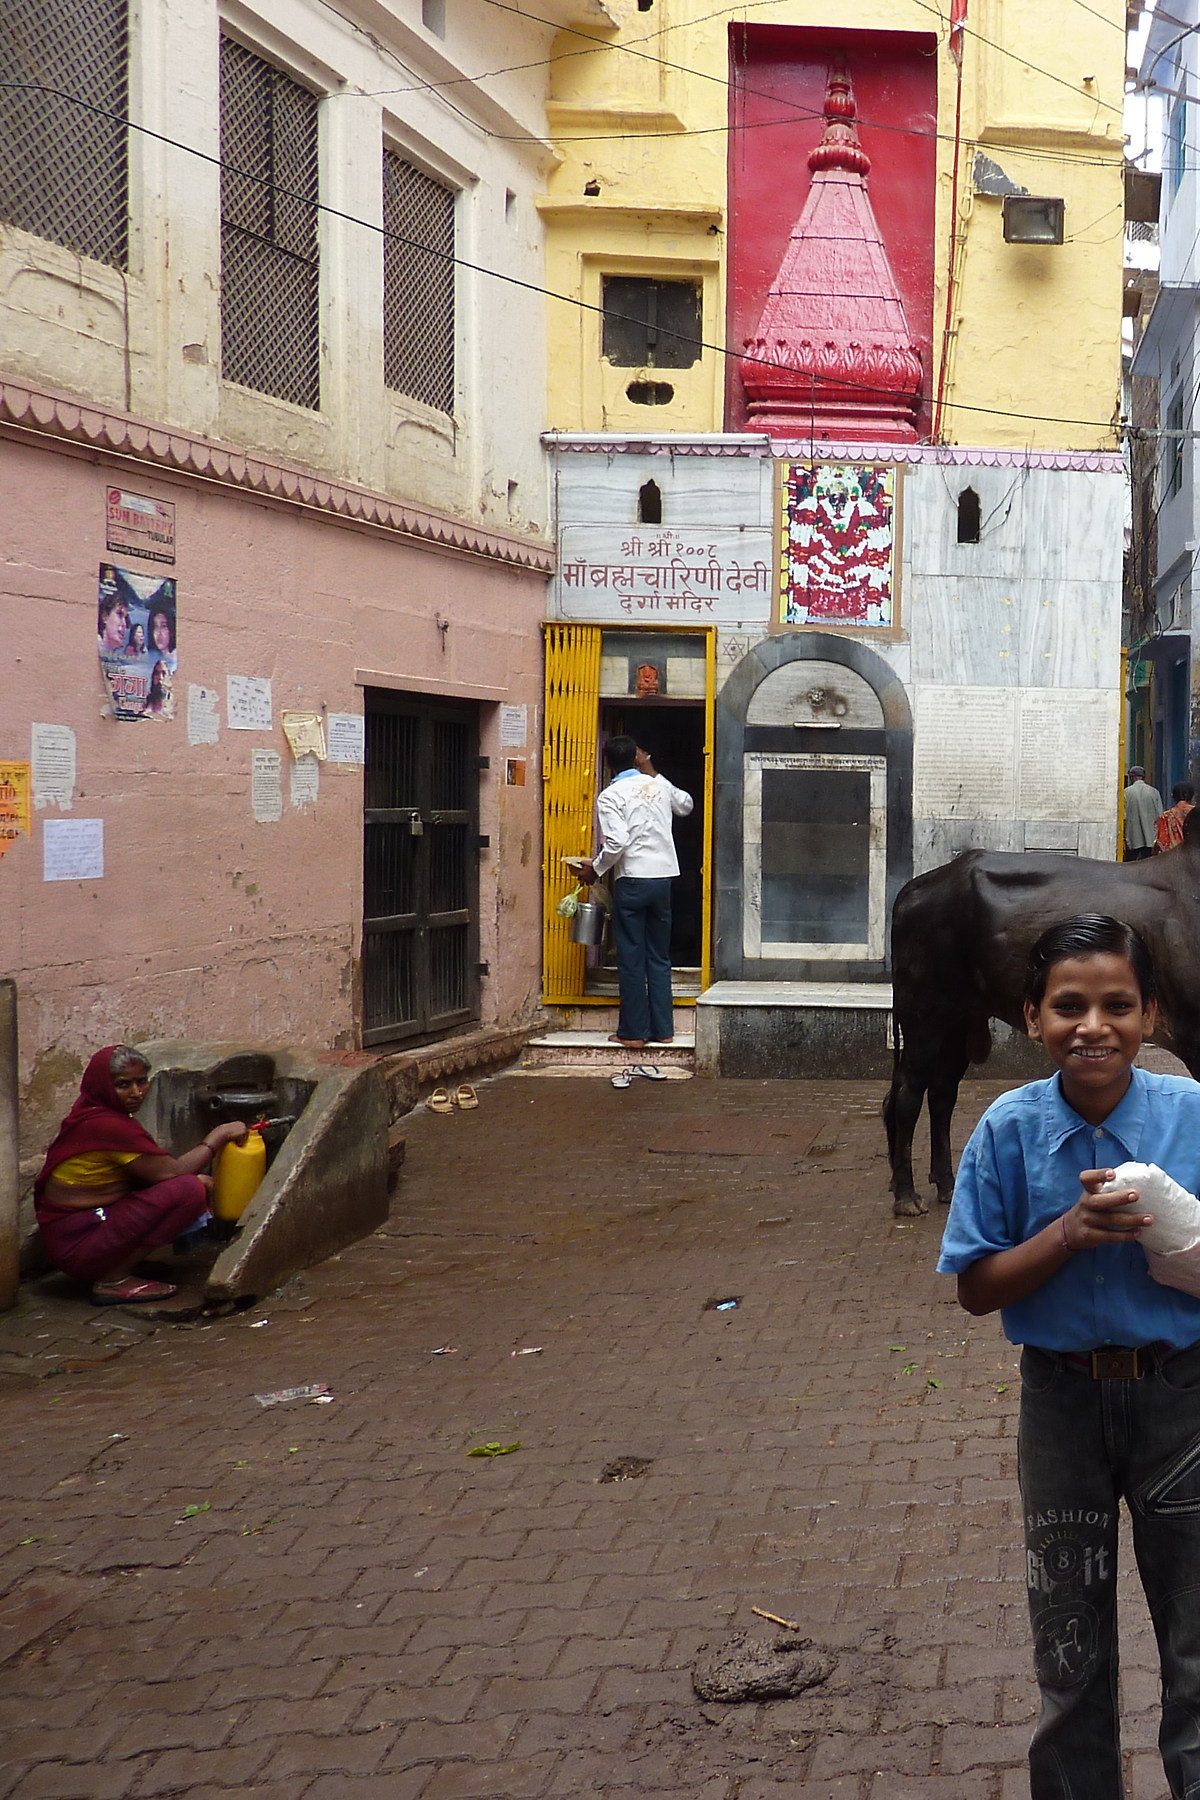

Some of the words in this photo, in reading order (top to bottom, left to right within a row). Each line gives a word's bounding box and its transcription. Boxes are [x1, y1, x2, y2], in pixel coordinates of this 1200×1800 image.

[621, 536, 644, 557] श्री
[648, 539, 671, 557] श्री
[676, 543, 718, 558] १००८
[563, 556, 588, 588] माँ
[589, 557, 724, 593] ब्रह्मचारिणी
[726, 560, 771, 594] देवी
[618, 590, 662, 614] दुर्गा
[663, 590, 720, 614] मंदिर
[108, 669, 147, 698] गंगा
[1027, 1509, 1109, 1532] FASHION
